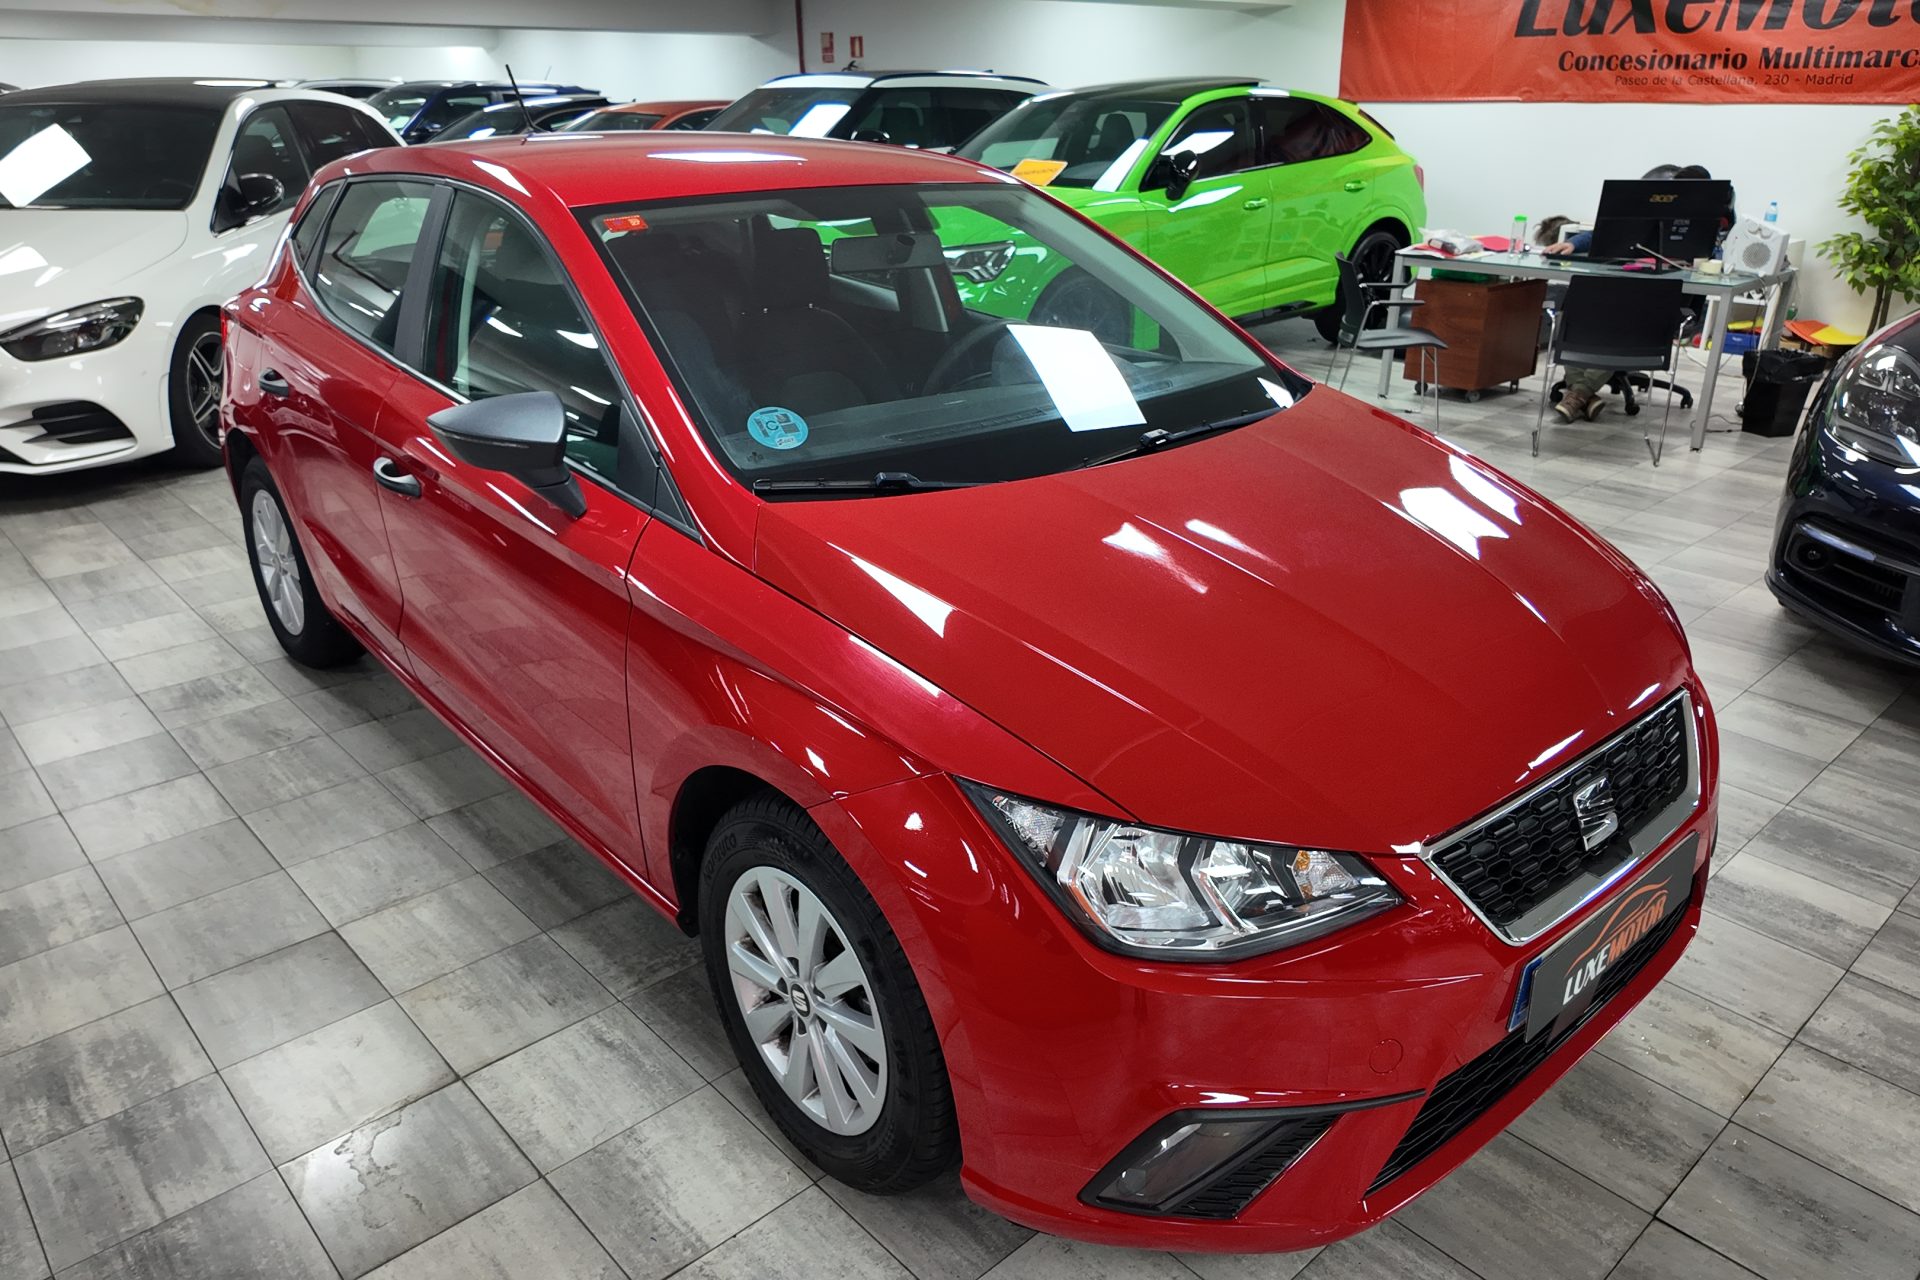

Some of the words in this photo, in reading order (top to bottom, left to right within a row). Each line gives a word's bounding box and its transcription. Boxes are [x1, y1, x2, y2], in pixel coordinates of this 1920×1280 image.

[1515, 0, 1920, 37] LuxeMot
[1558, 49, 1747, 72] Concesionario
[1758, 45, 1920, 70] Multimarc
[1615, 75, 1648, 86] Paseo
[1652, 75, 1667, 86] de
[1671, 75, 1682, 86] la
[1687, 75, 1758, 87] Castellana,
[1764, 74, 1789, 86] 230
[1806, 73, 1854, 86] Madrid
[1649, 194, 1679, 203] acer
[1562, 895, 1667, 1006] LUXEMOTOR
